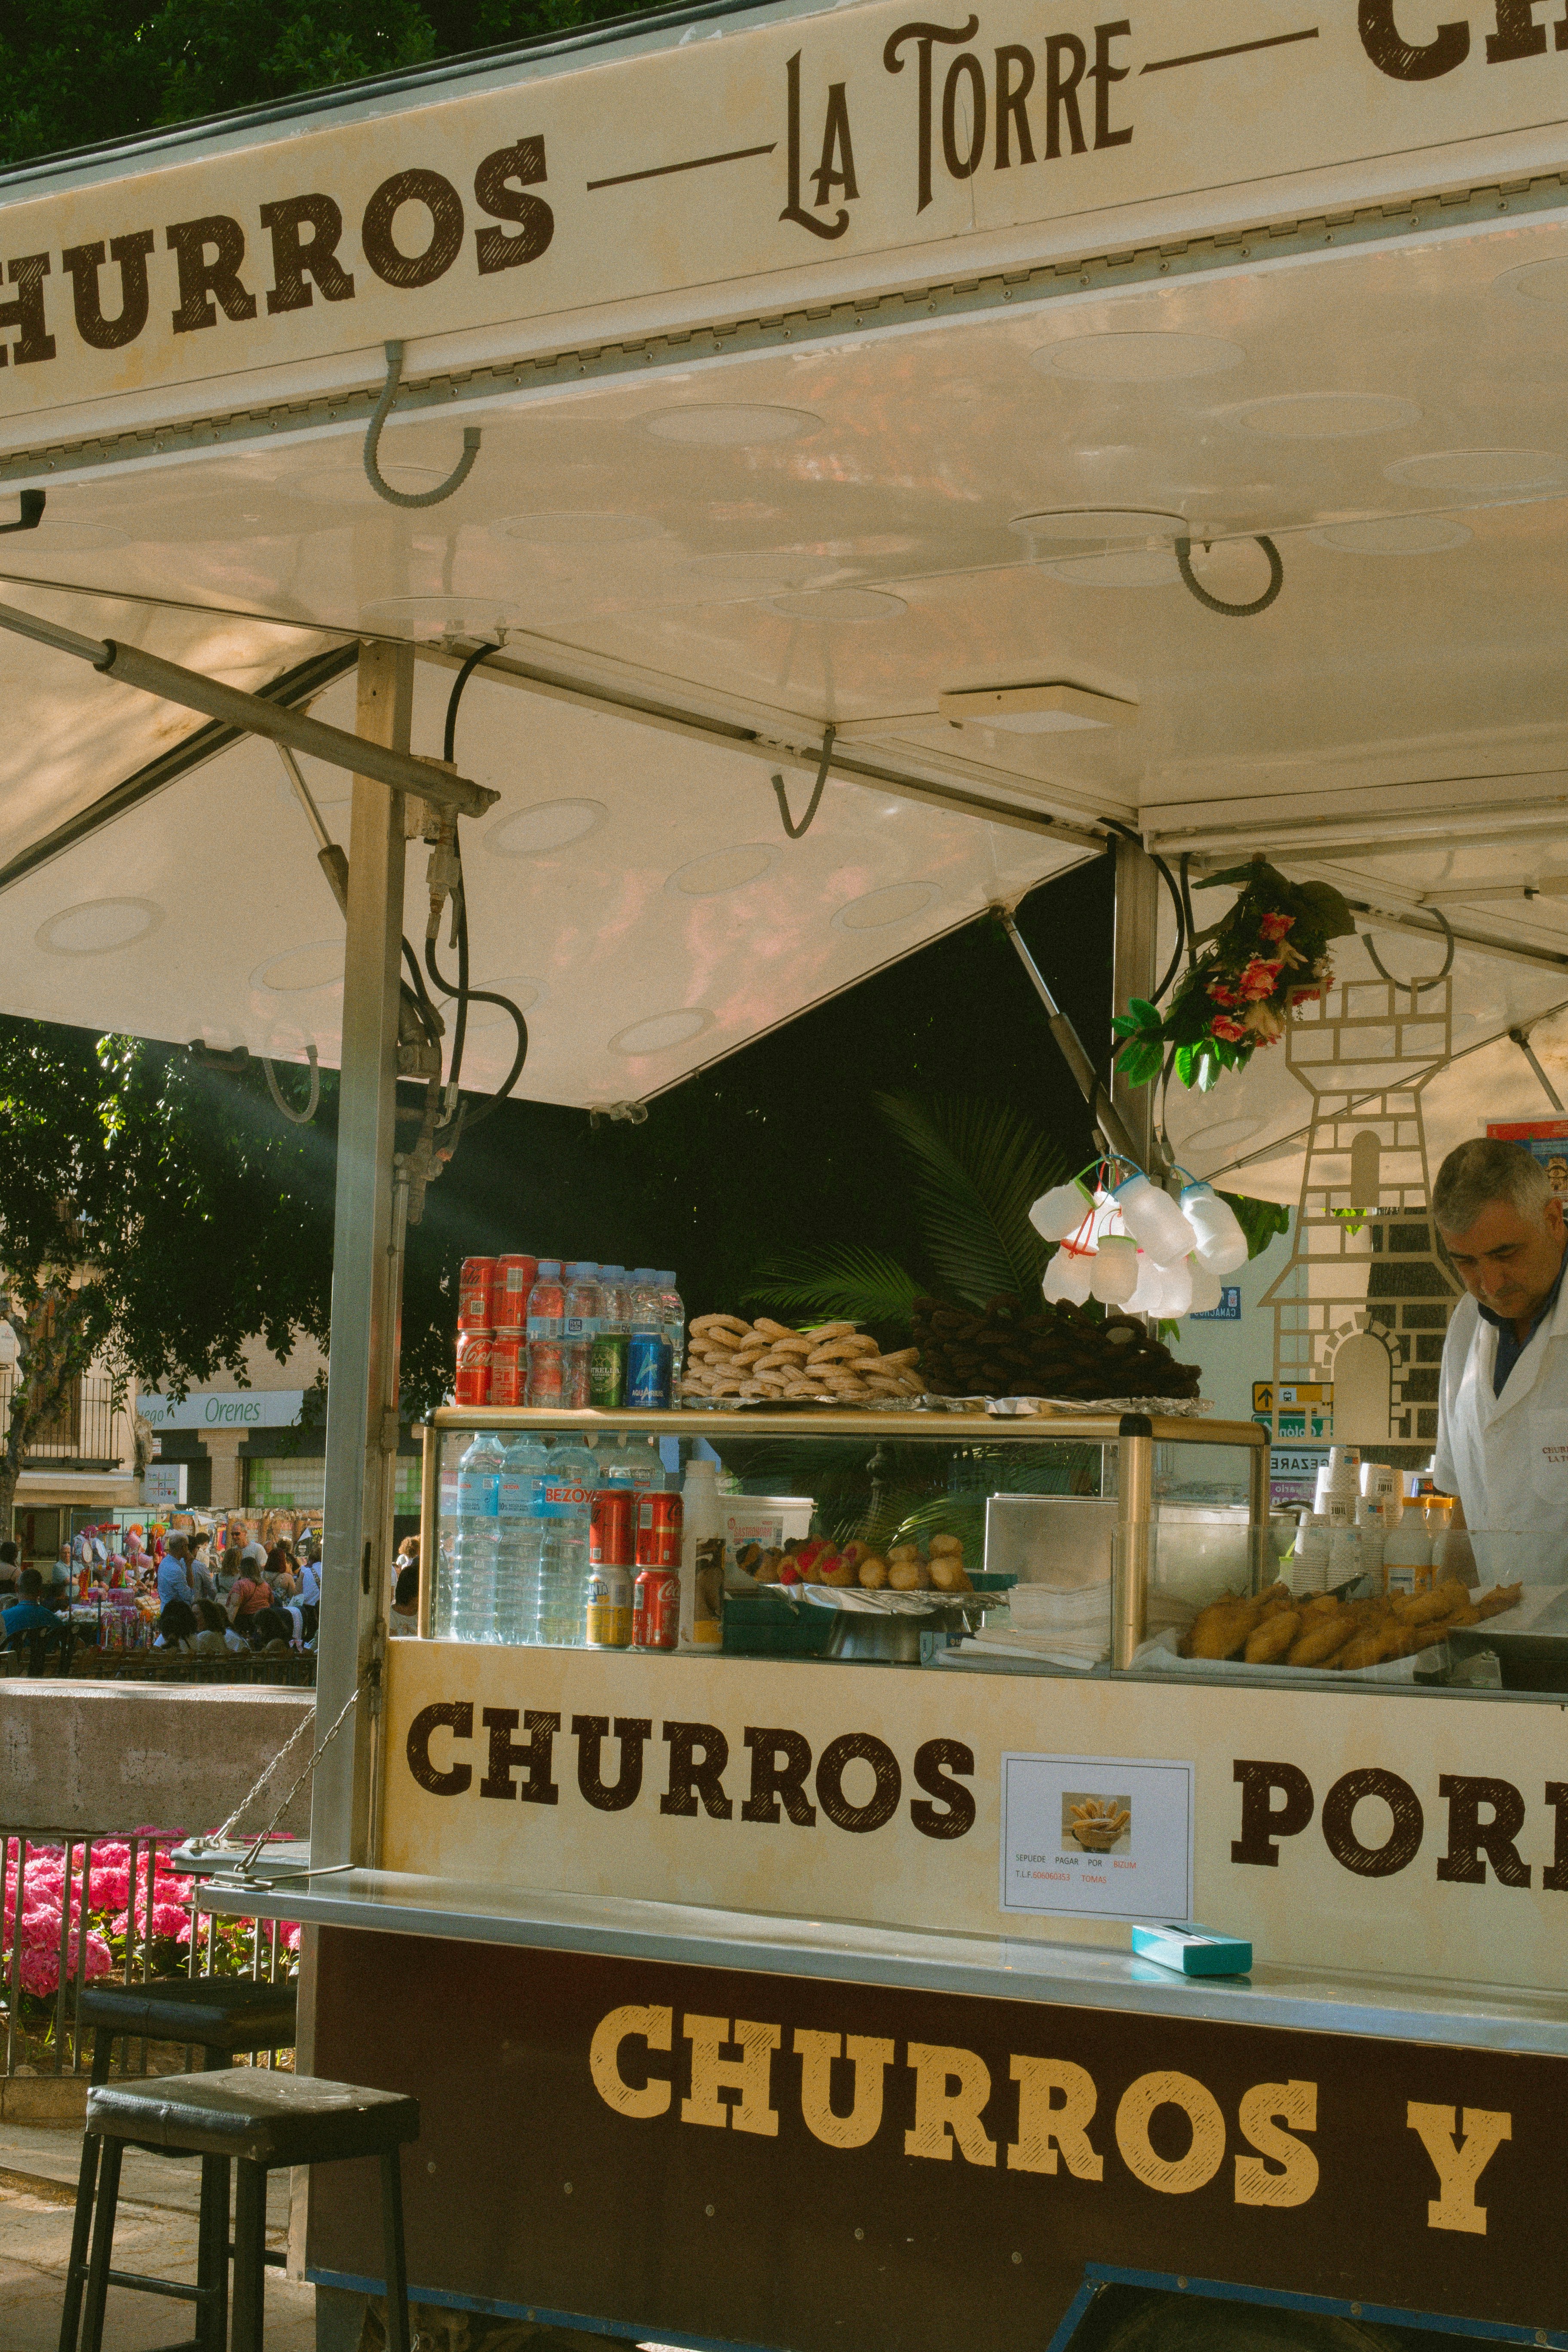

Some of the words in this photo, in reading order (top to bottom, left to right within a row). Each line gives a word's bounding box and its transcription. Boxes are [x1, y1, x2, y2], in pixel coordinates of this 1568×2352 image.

[778, 47, 860, 240] LA
[883, 14, 1135, 216] TORRE
[205, 1397, 260, 1422] Orenes
[632, 1387, 664, 1400] AQUARIUS
[406, 1701, 976, 1840] CHURROS
[1055, 1857, 1078, 1865] PAGAR
[1231, 1759, 1568, 1891] POR
[1081, 1874, 1107, 1883] TOMAS
[589, 2004, 1320, 2208] CHURROS
[1407, 2100, 1512, 2235] Y
